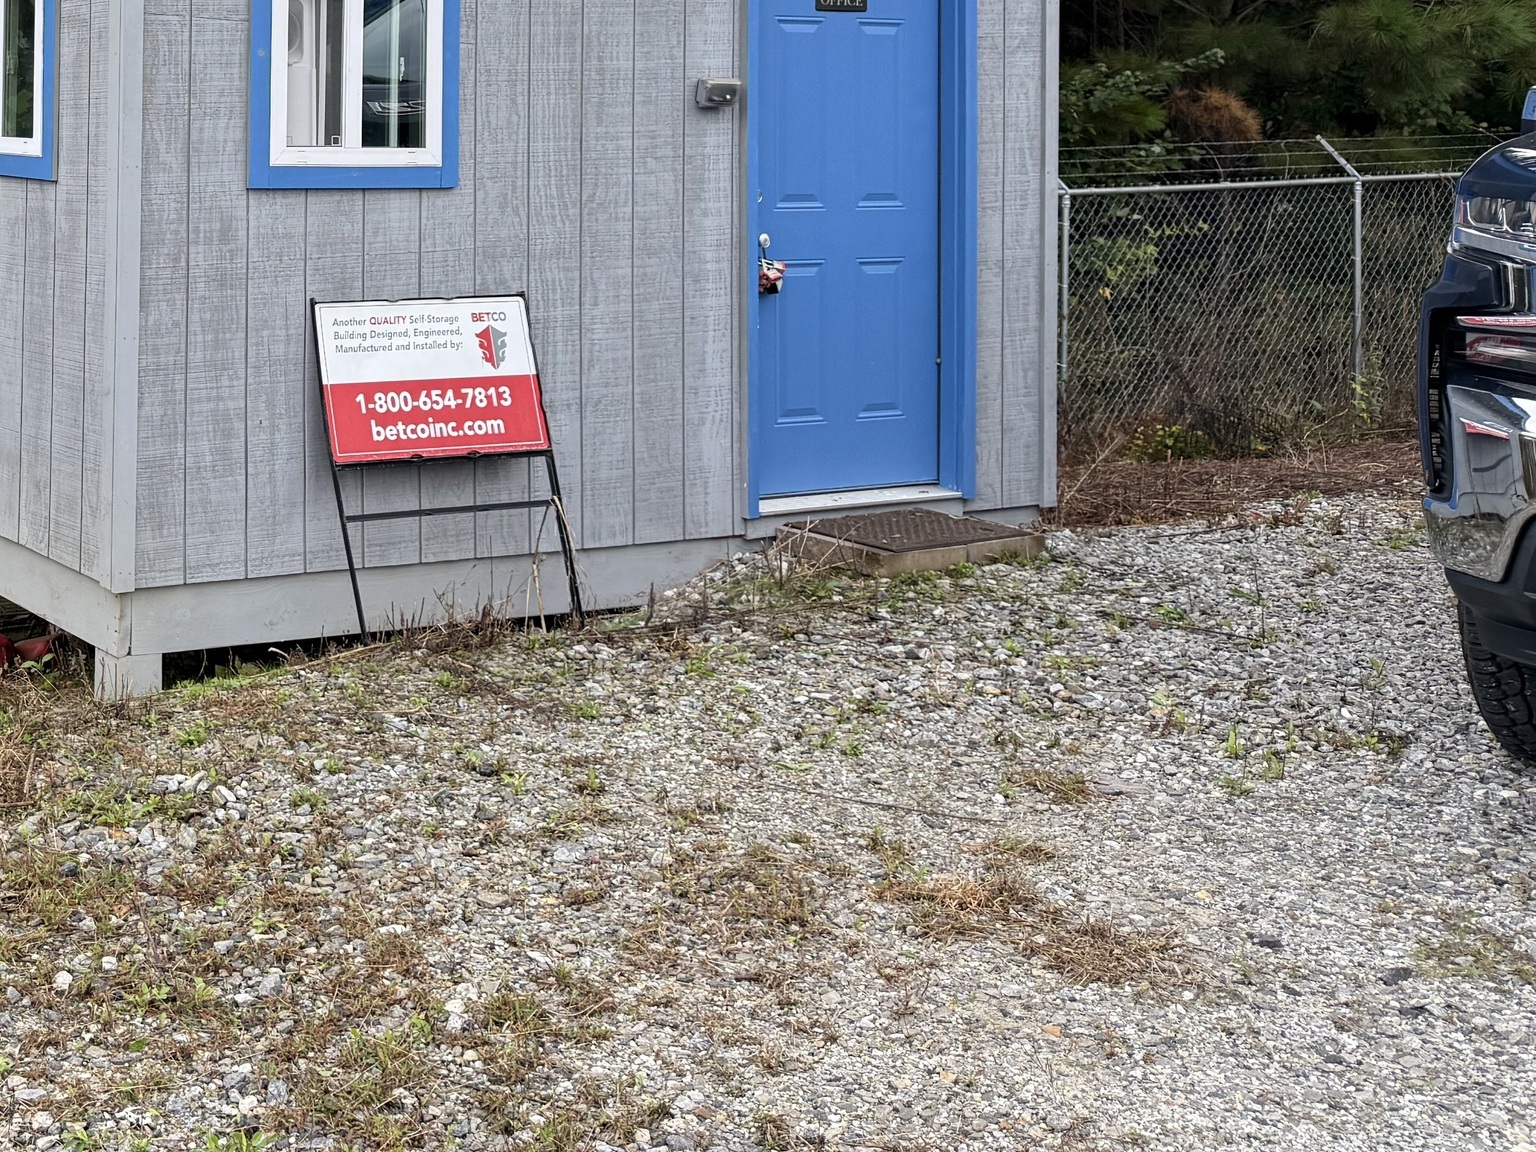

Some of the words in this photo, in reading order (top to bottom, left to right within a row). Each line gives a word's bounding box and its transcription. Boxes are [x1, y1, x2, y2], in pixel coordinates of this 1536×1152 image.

[332, 317, 367, 327] Another
[369, 315, 407, 326] QUALITY
[409, 314, 460, 325] Self-Storage
[471, 311, 507, 323] BETCO
[333, 330, 368, 342] Building
[370, 328, 411, 341] Designed,
[413, 326, 463, 339] Engineered,
[335, 342, 393, 354] Manufactured
[395, 341, 411, 351] and
[413, 340, 448, 351] Installed
[450, 339, 464, 351] by:
[355, 385, 513, 415] 1-800-654-7813
[370, 417, 506, 442] betcoinc.com
